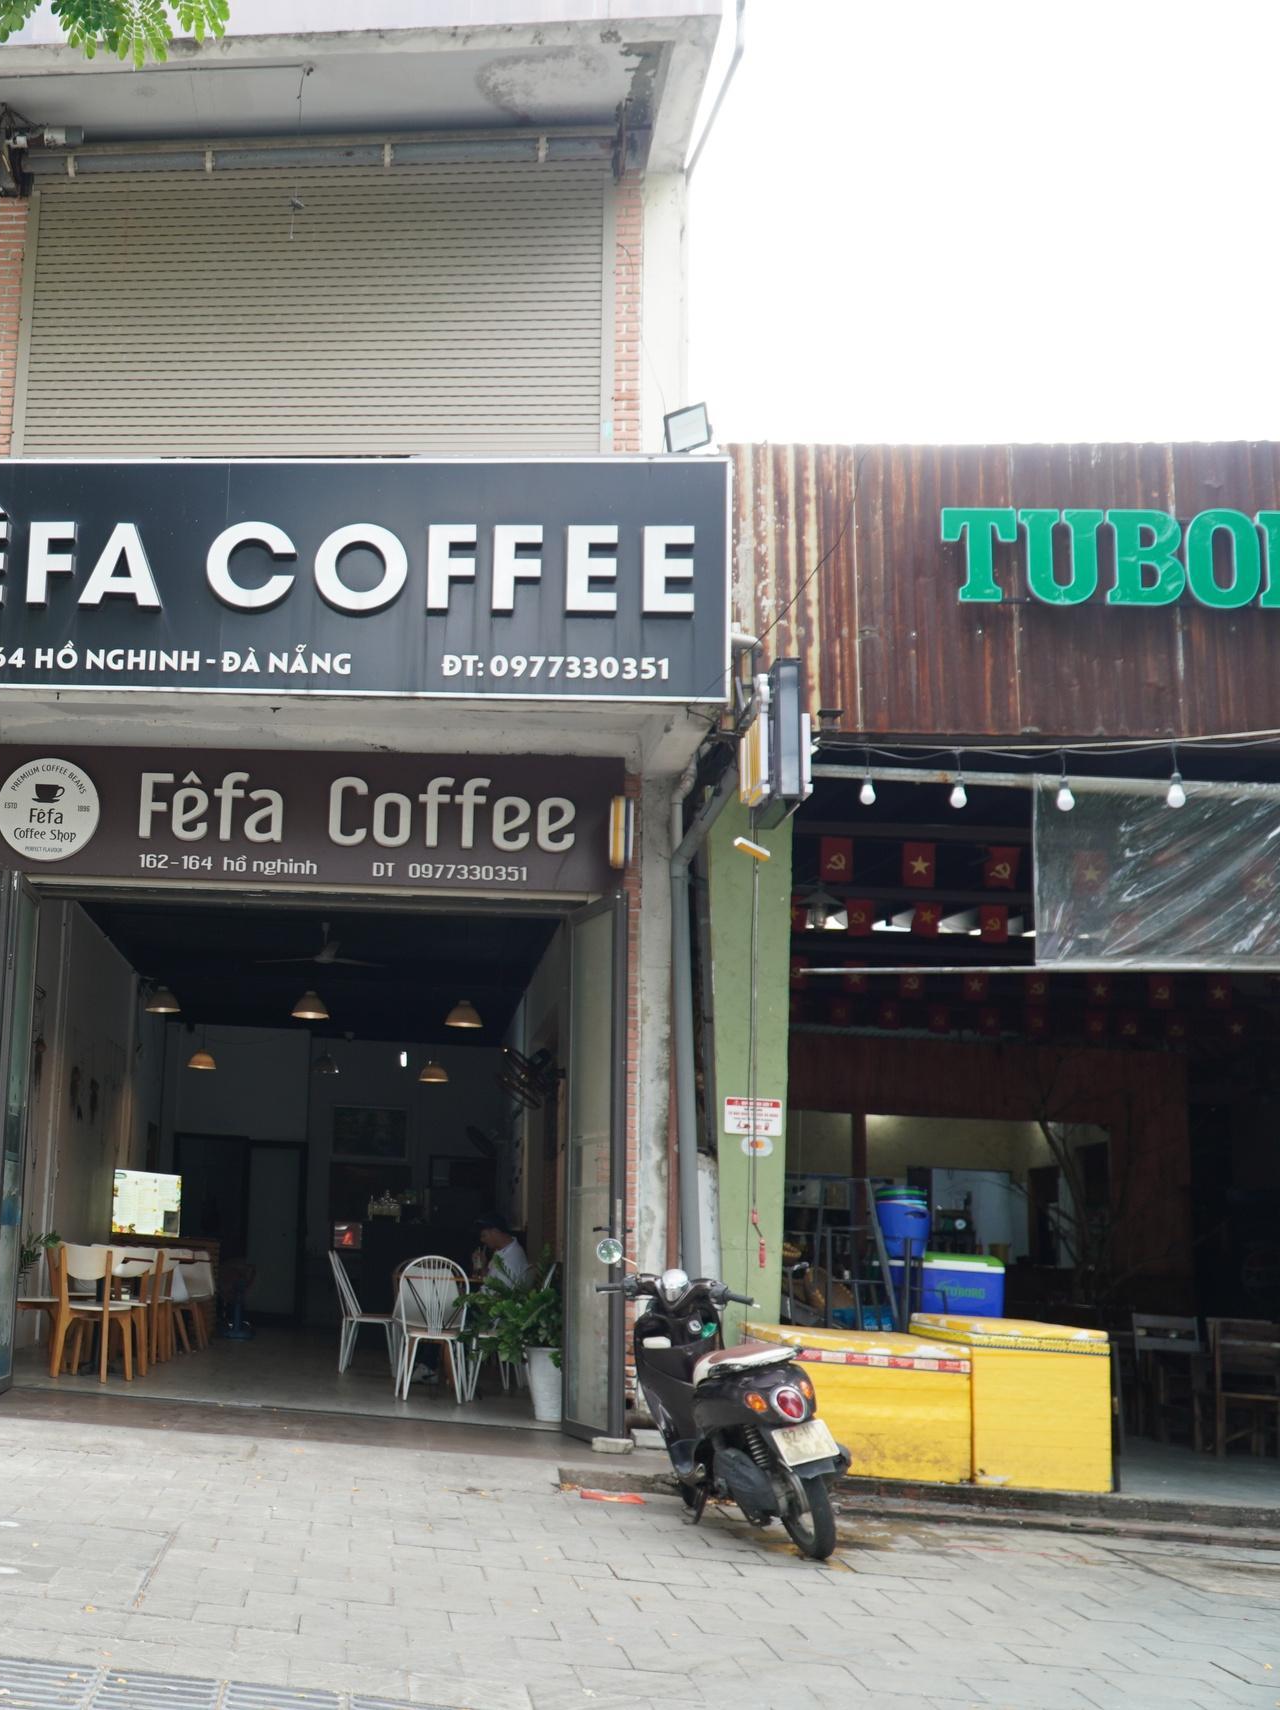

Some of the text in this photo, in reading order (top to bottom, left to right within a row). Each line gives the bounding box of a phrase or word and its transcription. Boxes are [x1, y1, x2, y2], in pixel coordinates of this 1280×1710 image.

[205, 520, 697, 616] COFFEE
[35, 640, 79, 670] HỒ
[440, 654, 670, 680] ĐT: 0977330351
[10, 764, 87, 795] PREMIUM COFFEE BEANS
[29, 808, 64, 824] Fêfa
[137, 770, 577, 852] Fêfa Coffee
[13, 827, 77, 843] Coffee Shop
[138, 853, 213, 871] 162-164
[223, 855, 247, 873] hồ
[253, 859, 318, 877] nghinh
[408, 863, 528, 882] 0977330351
